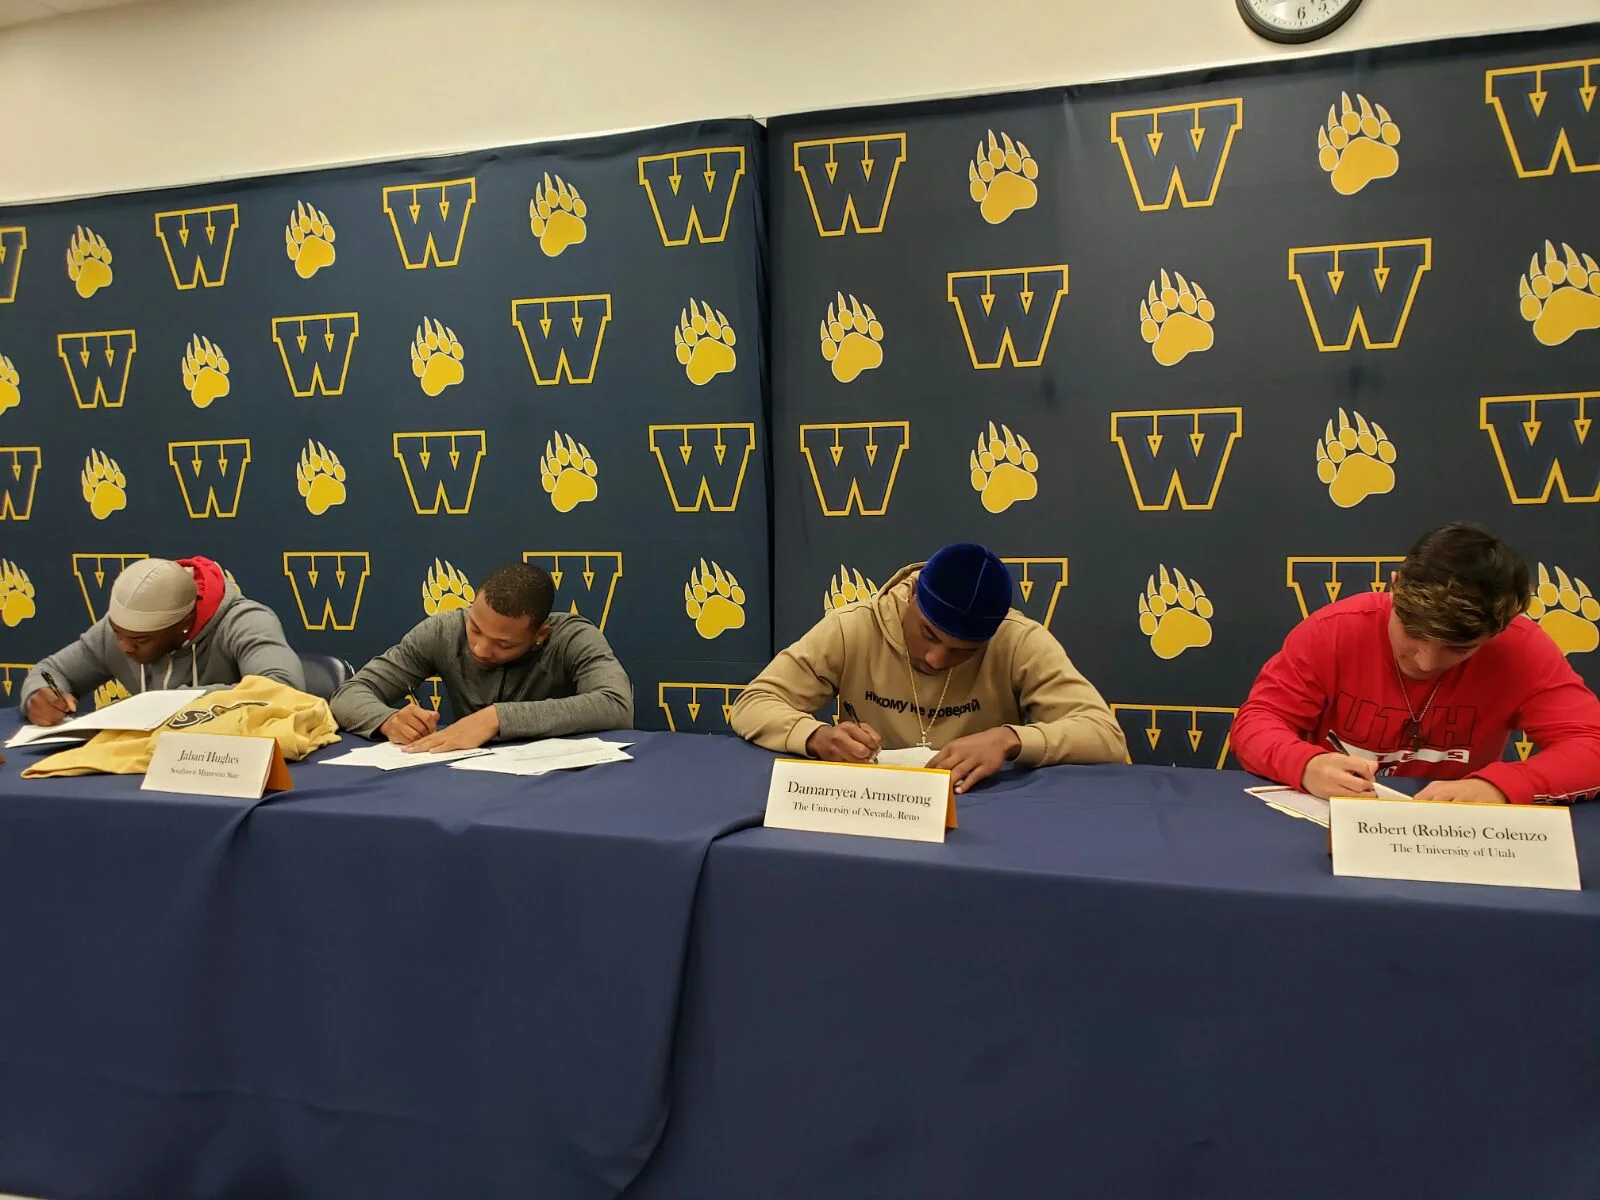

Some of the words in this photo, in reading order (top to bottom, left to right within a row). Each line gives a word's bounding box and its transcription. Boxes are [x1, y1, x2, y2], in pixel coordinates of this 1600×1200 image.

[1297, 6, 1306, 19] 6
[1110, 97, 1244, 212] W
[1485, 58, 1600, 178] W
[382, 177, 477, 270] W
[637, 146, 746, 247] W
[794, 132, 907, 236] W
[154, 204, 240, 291] W
[947, 264, 1070, 370] W
[1288, 238, 1433, 352] W
[57, 329, 137, 409] W
[271, 312, 360, 398] W
[511, 294, 613, 386] W
[167, 439, 252, 519] W
[392, 430, 487, 515] W
[649, 423, 756, 513] W
[799, 420, 910, 517] W
[1110, 407, 1243, 511] W
[1480, 391, 1600, 505] W
[282, 551, 371, 631] W
[206, 751, 239, 765] Hughes
[1336, 690, 1478, 750] UTAH
[787, 781, 857, 800] Damarryea
[860, 787, 931, 807] Armstrong
[793, 801, 809, 812] The
[811, 803, 850, 816] University
[852, 807, 863, 816] of
[898, 811, 920, 822] Reno
[1357, 821, 1407, 836] Robert
[1412, 823, 1477, 840] (Robbie)
[1483, 826, 1548, 842] Colenzo
[1390, 842, 1412, 854] The
[1416, 844, 1469, 858] University
[1473, 847, 1486, 858] of
[1488, 848, 1516, 859] Utah
